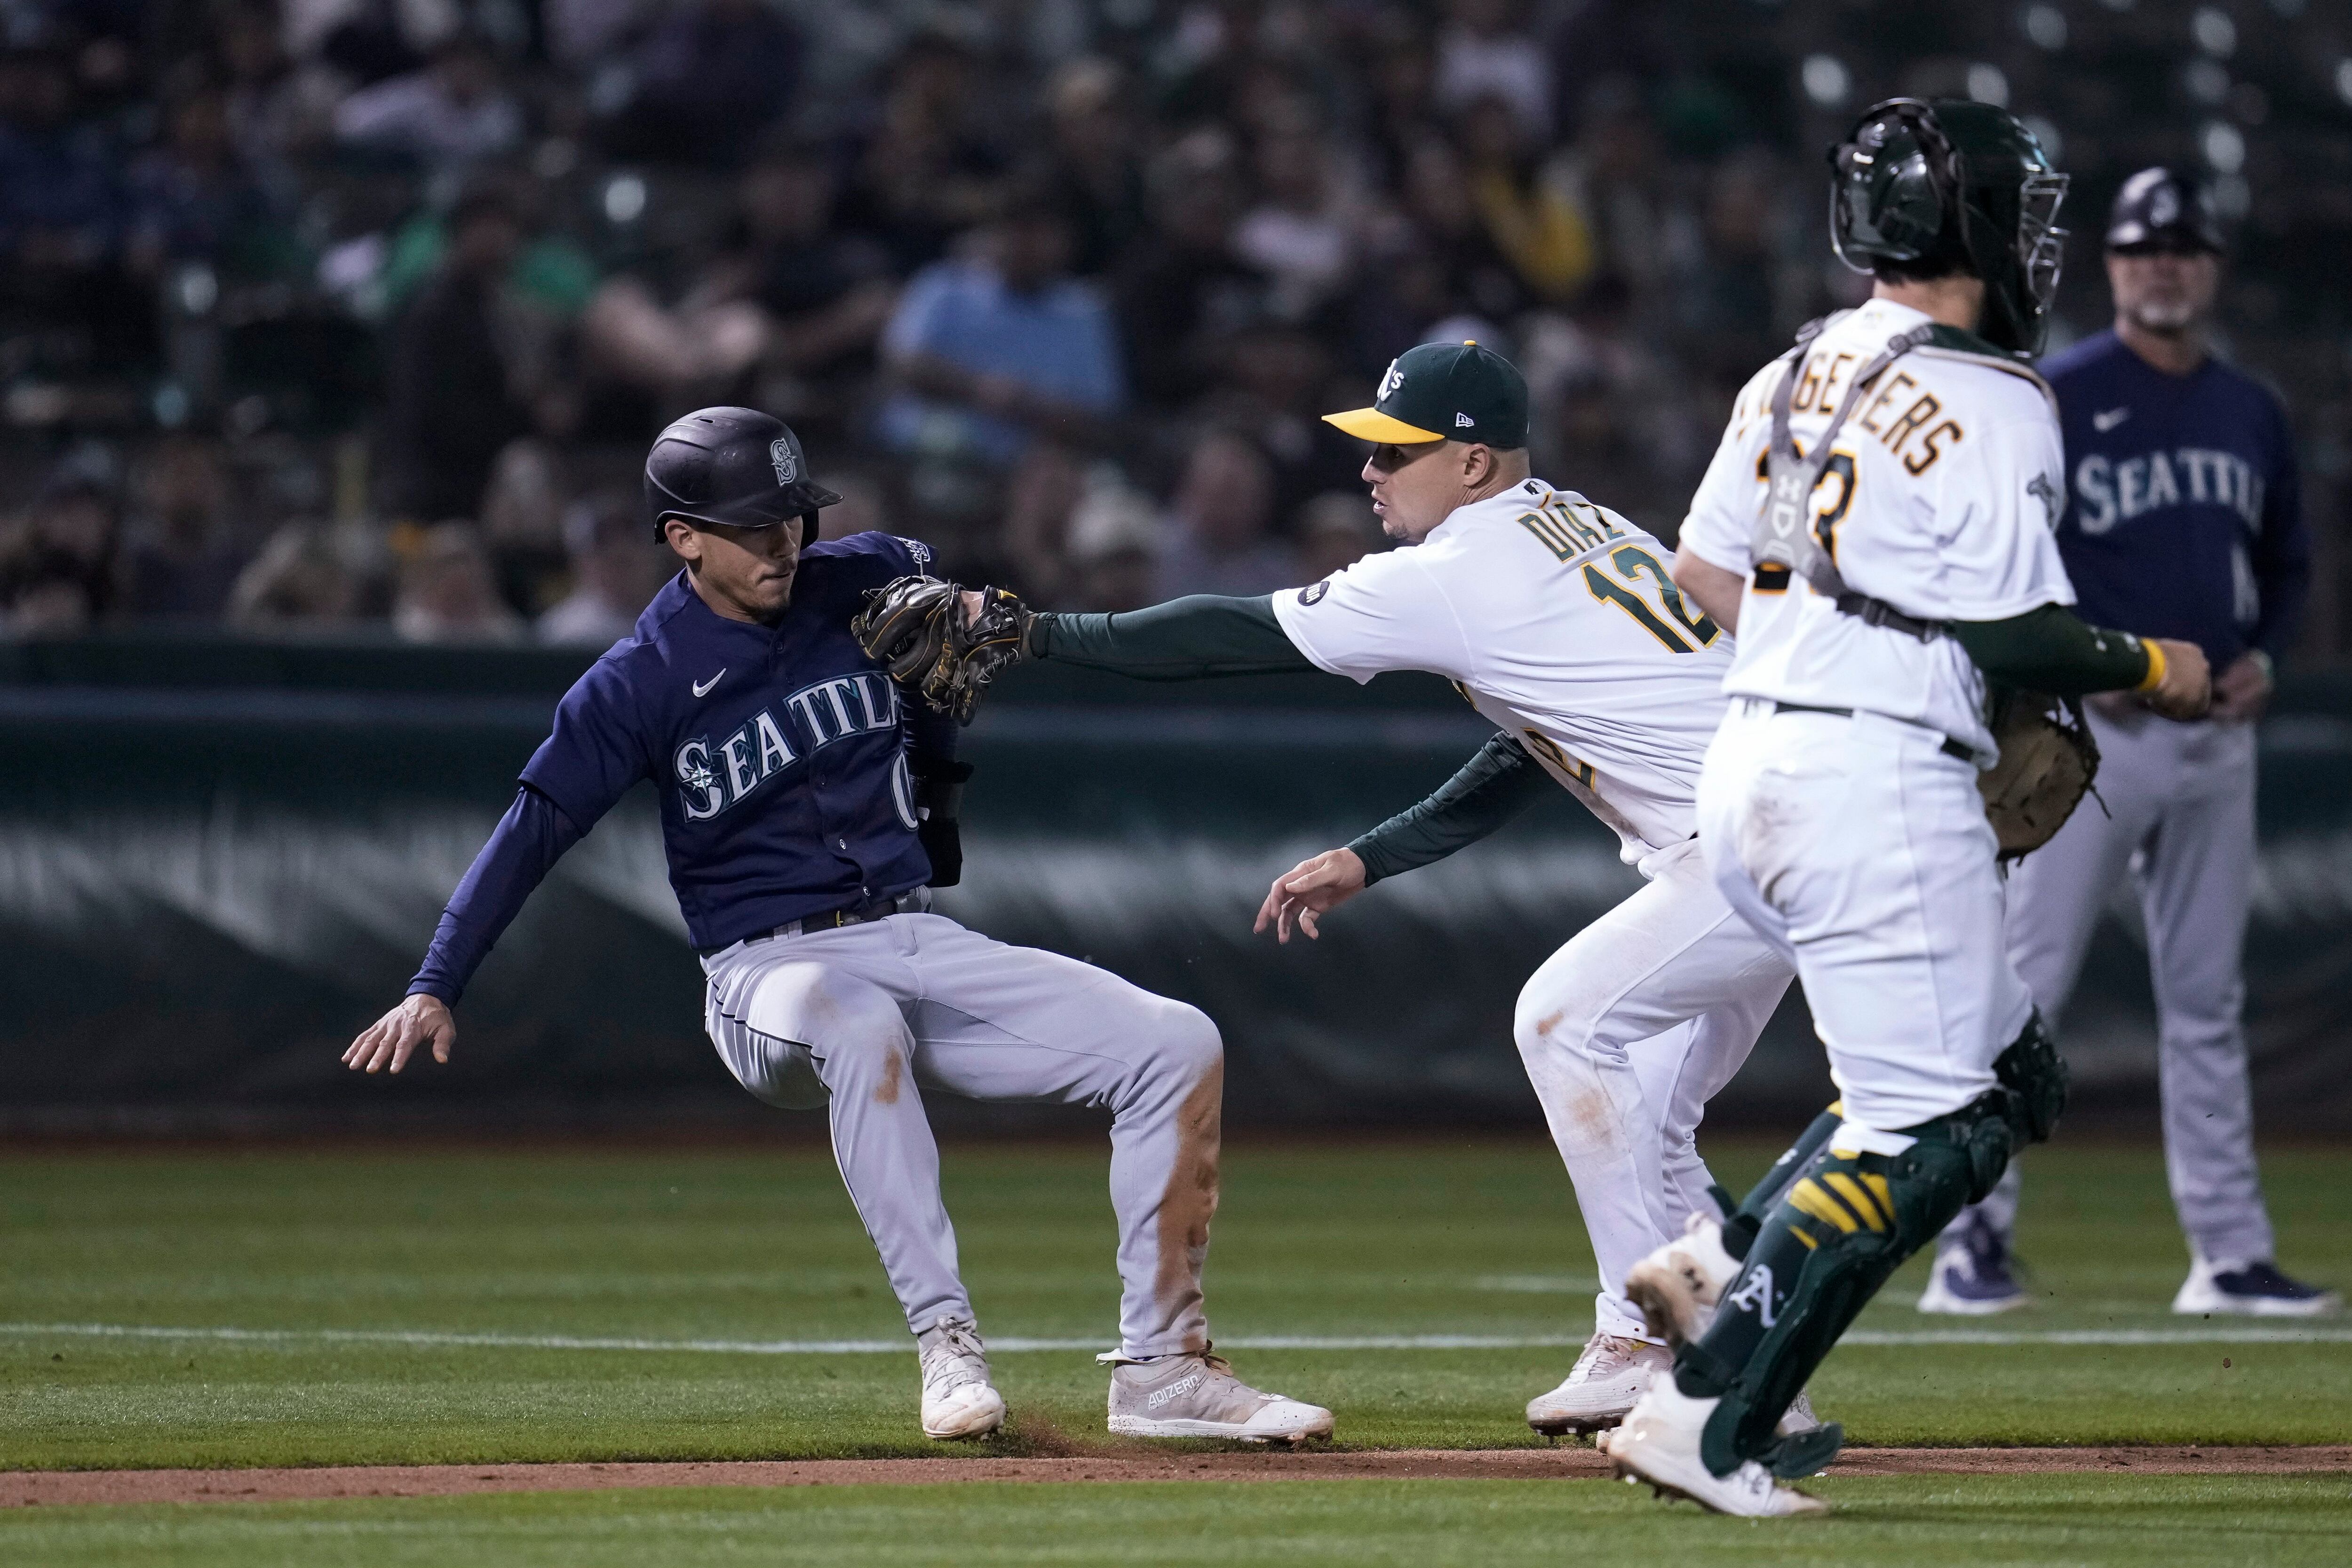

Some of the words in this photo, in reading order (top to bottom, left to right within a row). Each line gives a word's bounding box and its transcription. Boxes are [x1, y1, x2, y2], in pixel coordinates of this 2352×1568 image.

[771, 437, 796, 487] S
[1580, 543, 1723, 654] 12
[1148, 1375, 1200, 1408] ADIZERO
